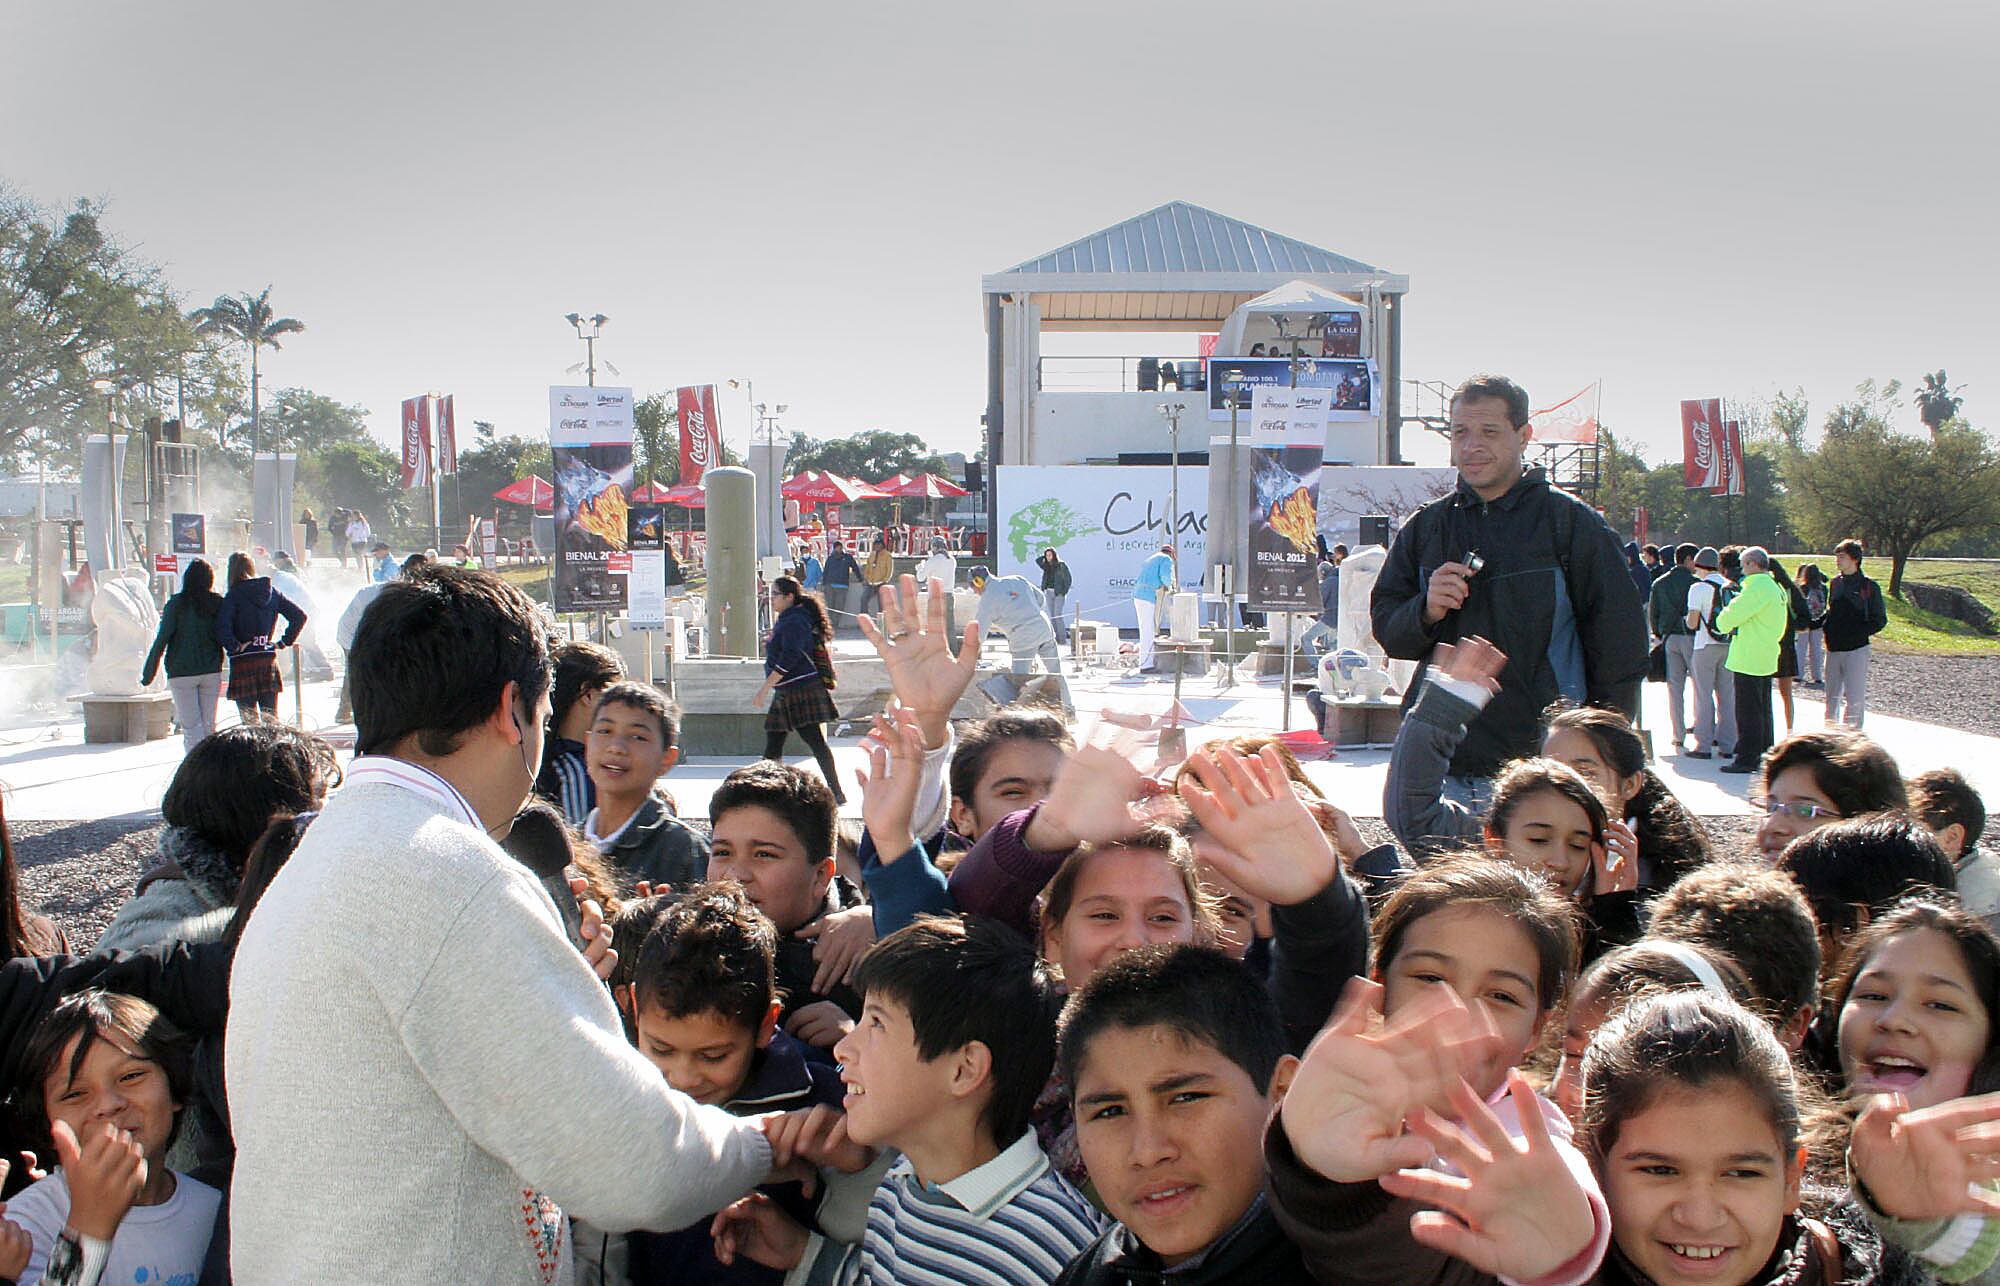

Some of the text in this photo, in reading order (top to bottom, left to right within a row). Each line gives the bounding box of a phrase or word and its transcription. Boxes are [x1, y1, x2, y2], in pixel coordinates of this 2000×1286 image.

[1296, 397, 1323, 405] Libertad
[565, 551, 598, 561] BIENAL
[1257, 552, 1307, 563] BIENAL 2012
